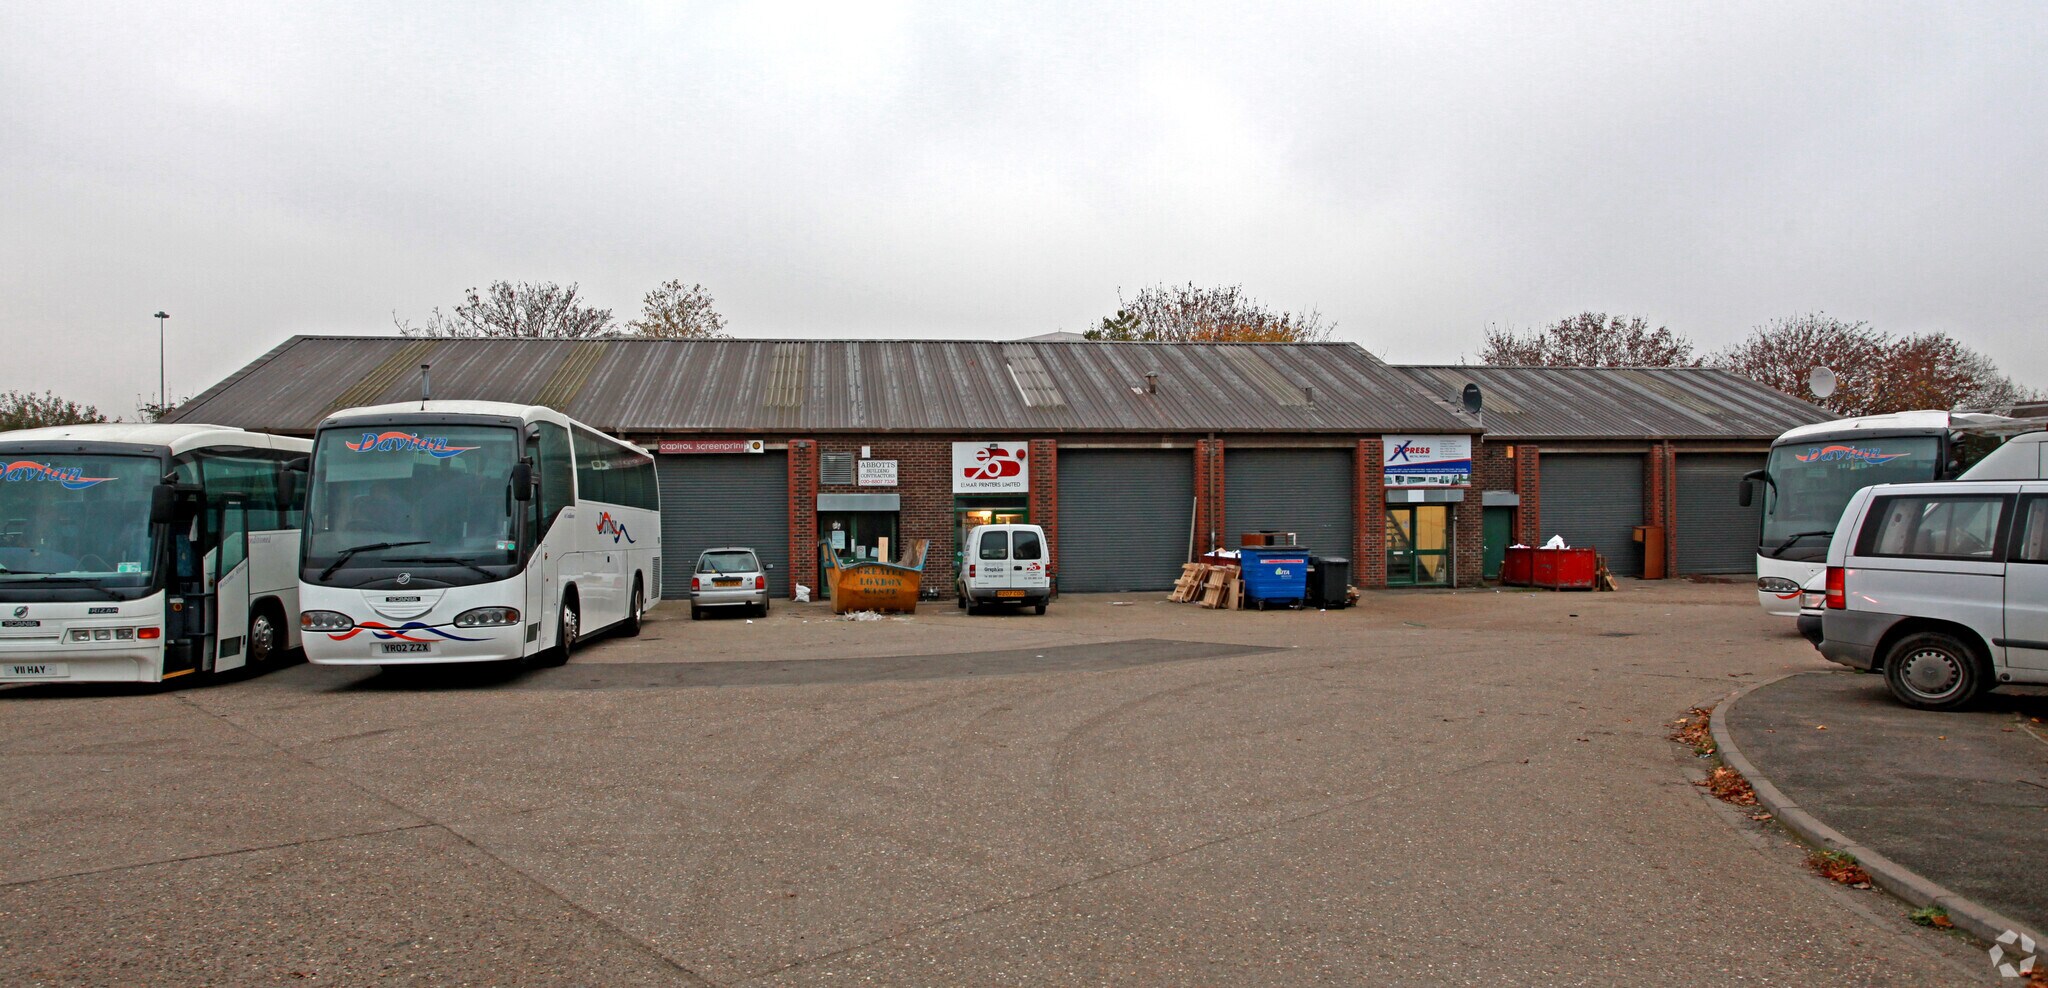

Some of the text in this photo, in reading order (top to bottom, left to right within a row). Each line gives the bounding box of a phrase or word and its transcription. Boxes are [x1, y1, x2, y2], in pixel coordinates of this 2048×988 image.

[358, 432, 448, 452] Davian
[1386, 440, 1431, 462] EXPRESS
[1803, 446, 1881, 462] Davian
[860, 577, 902, 586] LONDON
[384, 643, 428, 652] YR02 ZZX
[27, 665, 46, 674] HAY
